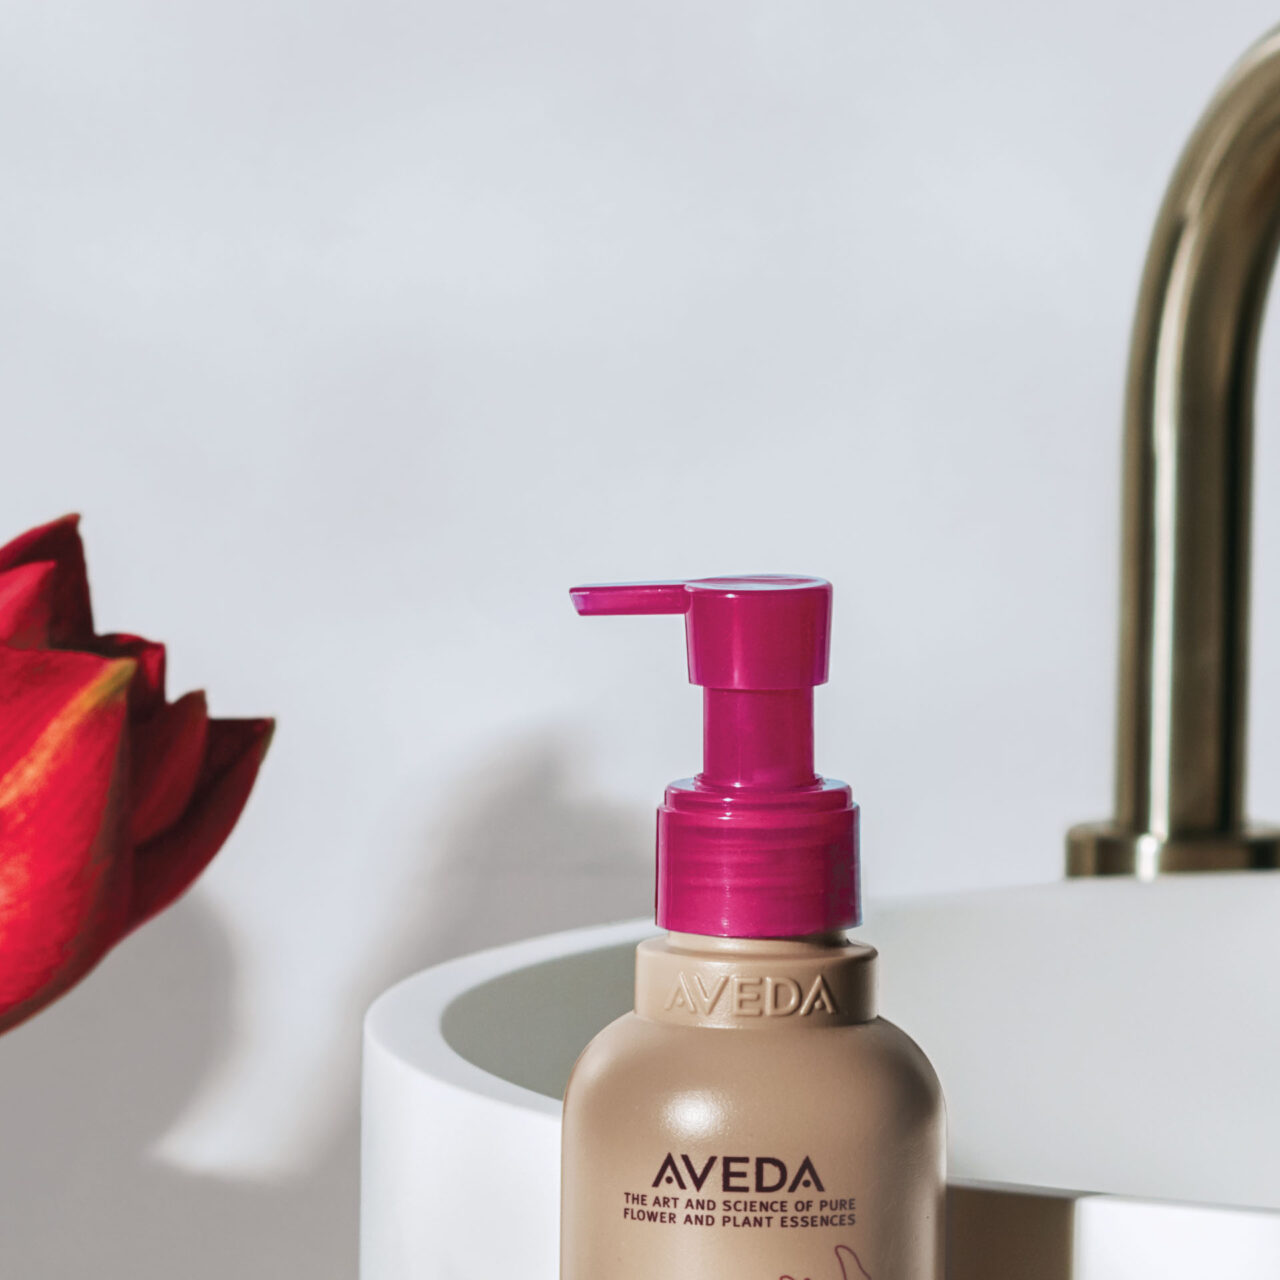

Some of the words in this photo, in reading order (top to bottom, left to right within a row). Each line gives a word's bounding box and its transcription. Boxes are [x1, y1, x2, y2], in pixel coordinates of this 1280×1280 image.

[665, 971, 838, 1018] AVEDA
[652, 1152, 825, 1192] AVEDA
[624, 1192, 648, 1206] THE
[652, 1196, 679, 1209] ART
[685, 1198, 716, 1211] AND
[722, 1200, 788, 1212] SCIENCE
[794, 1200, 813, 1212] OF
[820, 1198, 856, 1211] PURE
[624, 1208, 677, 1223] FLOWER
[683, 1214, 714, 1226] AND
[722, 1216, 773, 1228] PLANT
[780, 1213, 856, 1228] ESSENCES
